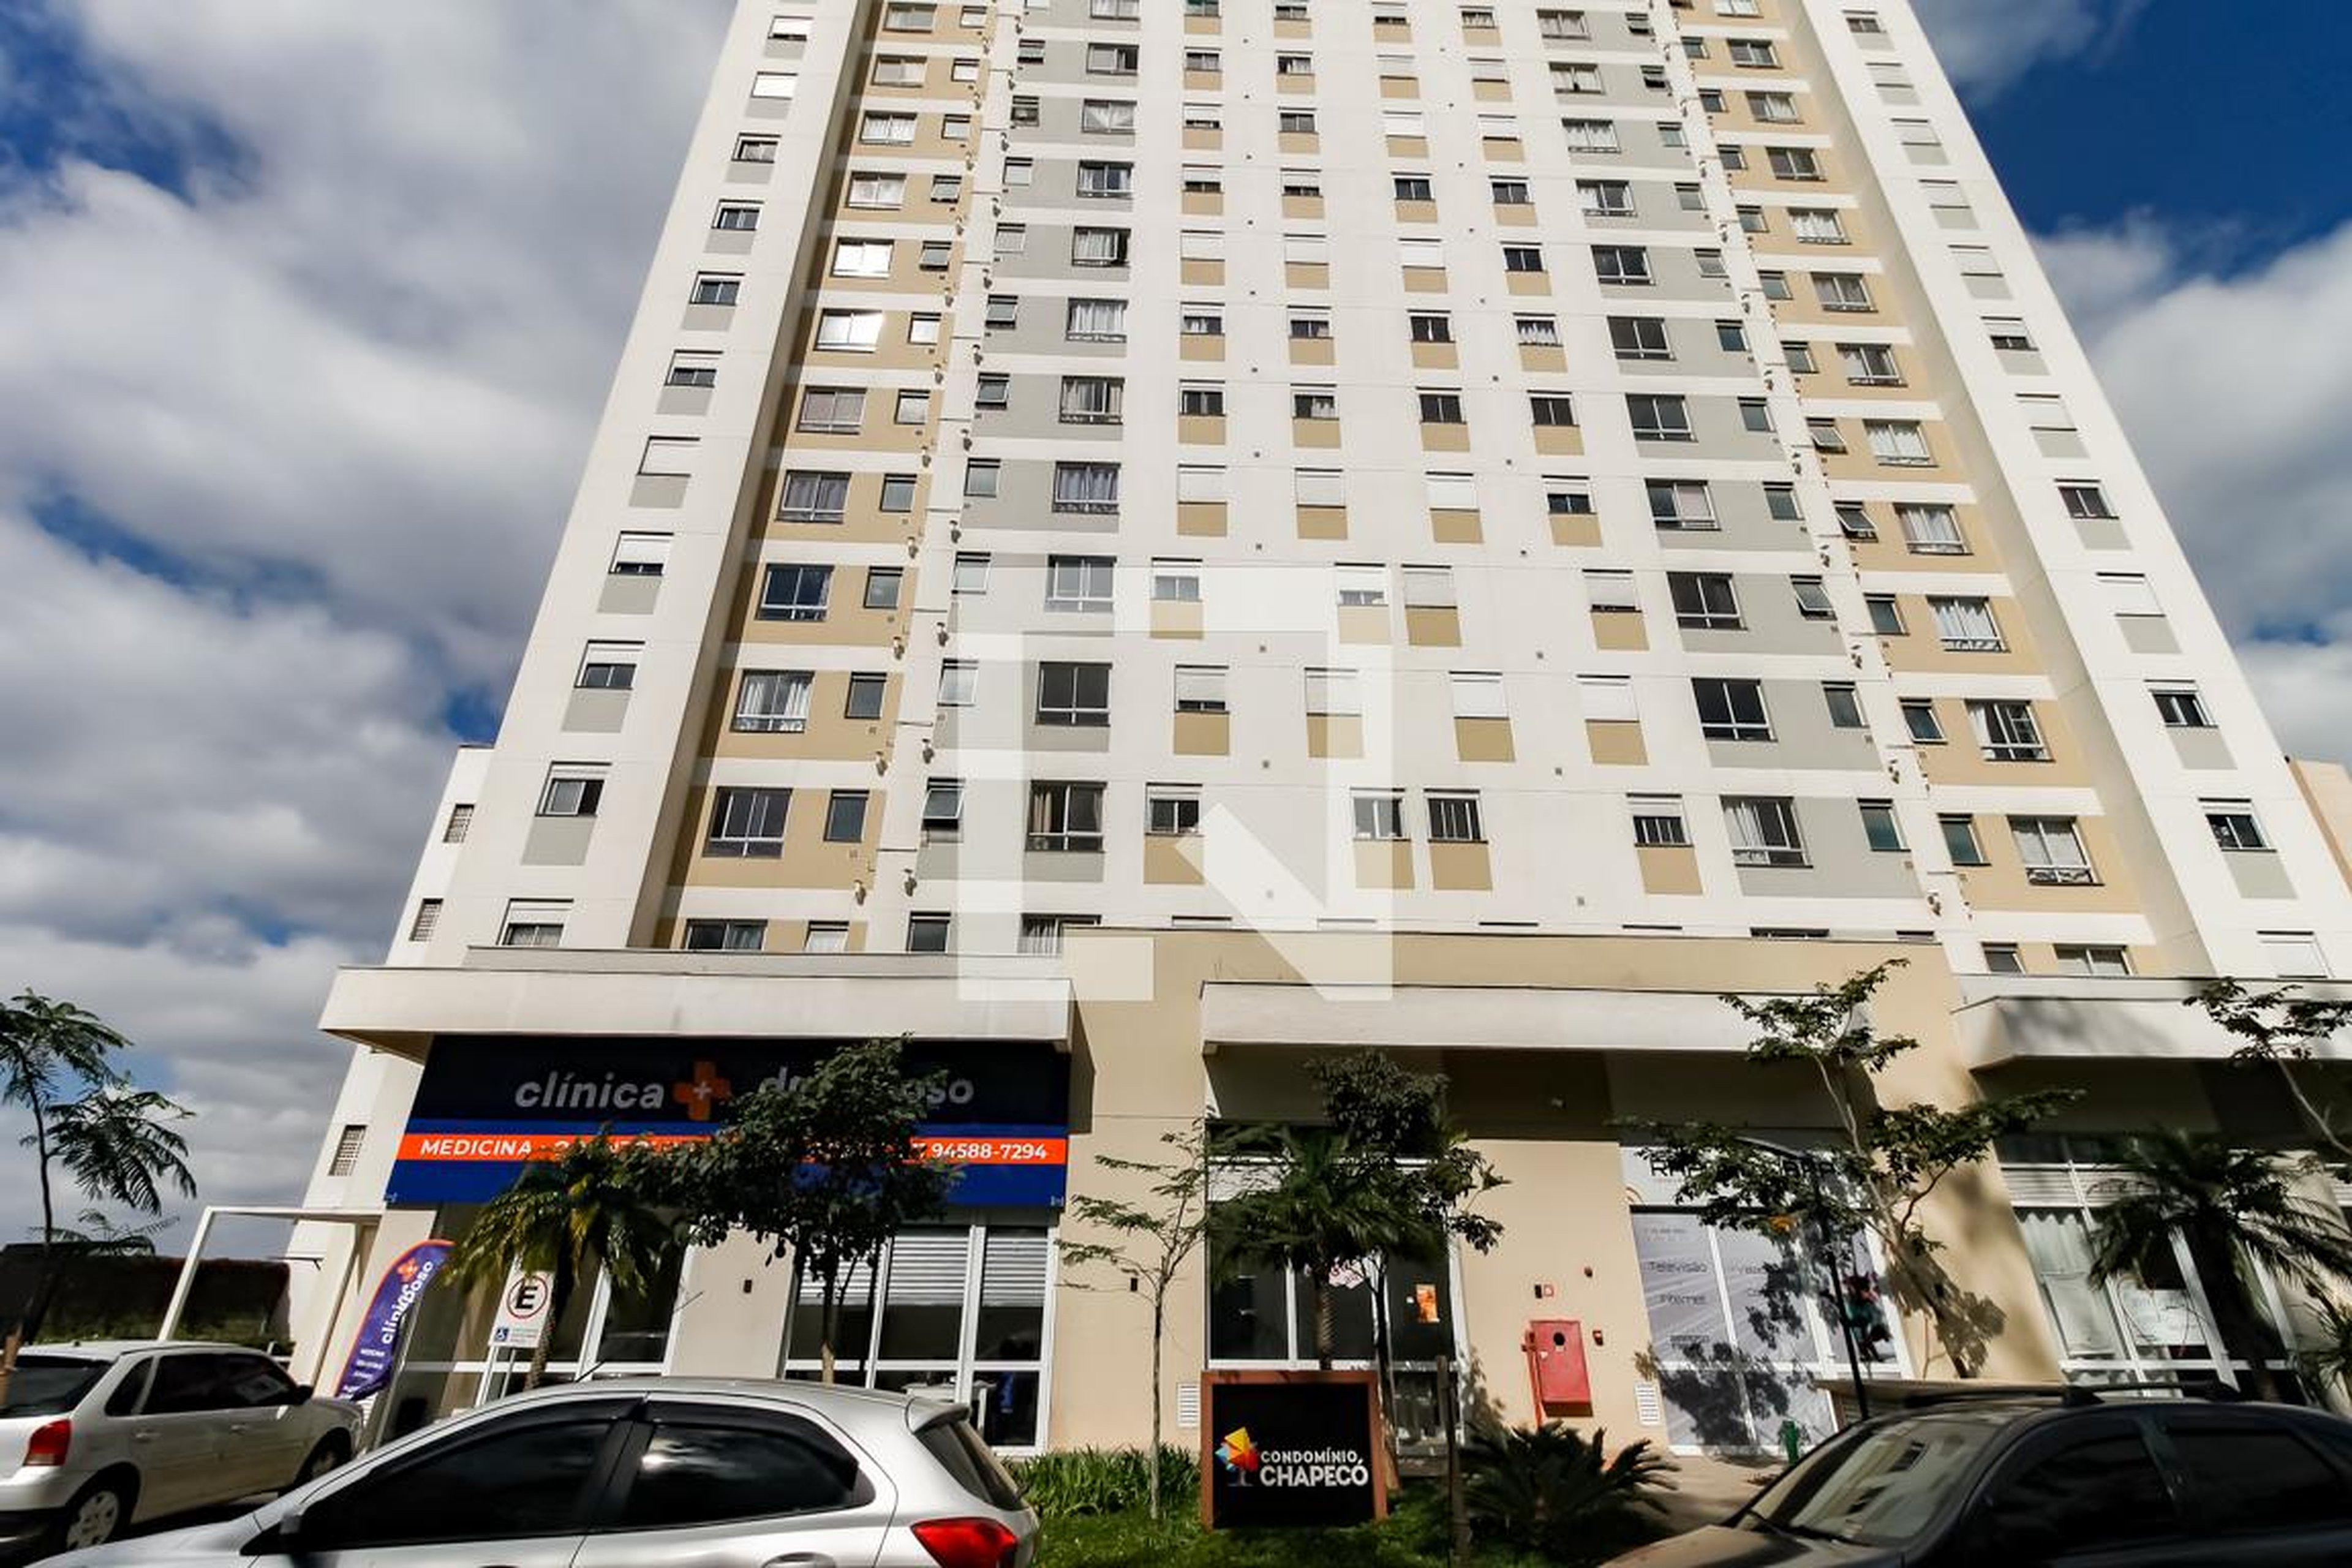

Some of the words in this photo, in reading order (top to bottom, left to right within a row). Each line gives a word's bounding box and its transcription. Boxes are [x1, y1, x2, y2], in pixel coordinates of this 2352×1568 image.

[514, 1069, 665, 1109] clínica
[420, 1139, 532, 1155] MEDICINA
[932, 1144, 1047, 1159] 94588-7294
[515, 1286, 538, 1309] E
[1261, 1447, 1358, 1463] CONDOMÍNIO
[1259, 1458, 1369, 1487] CHAPECÓ
